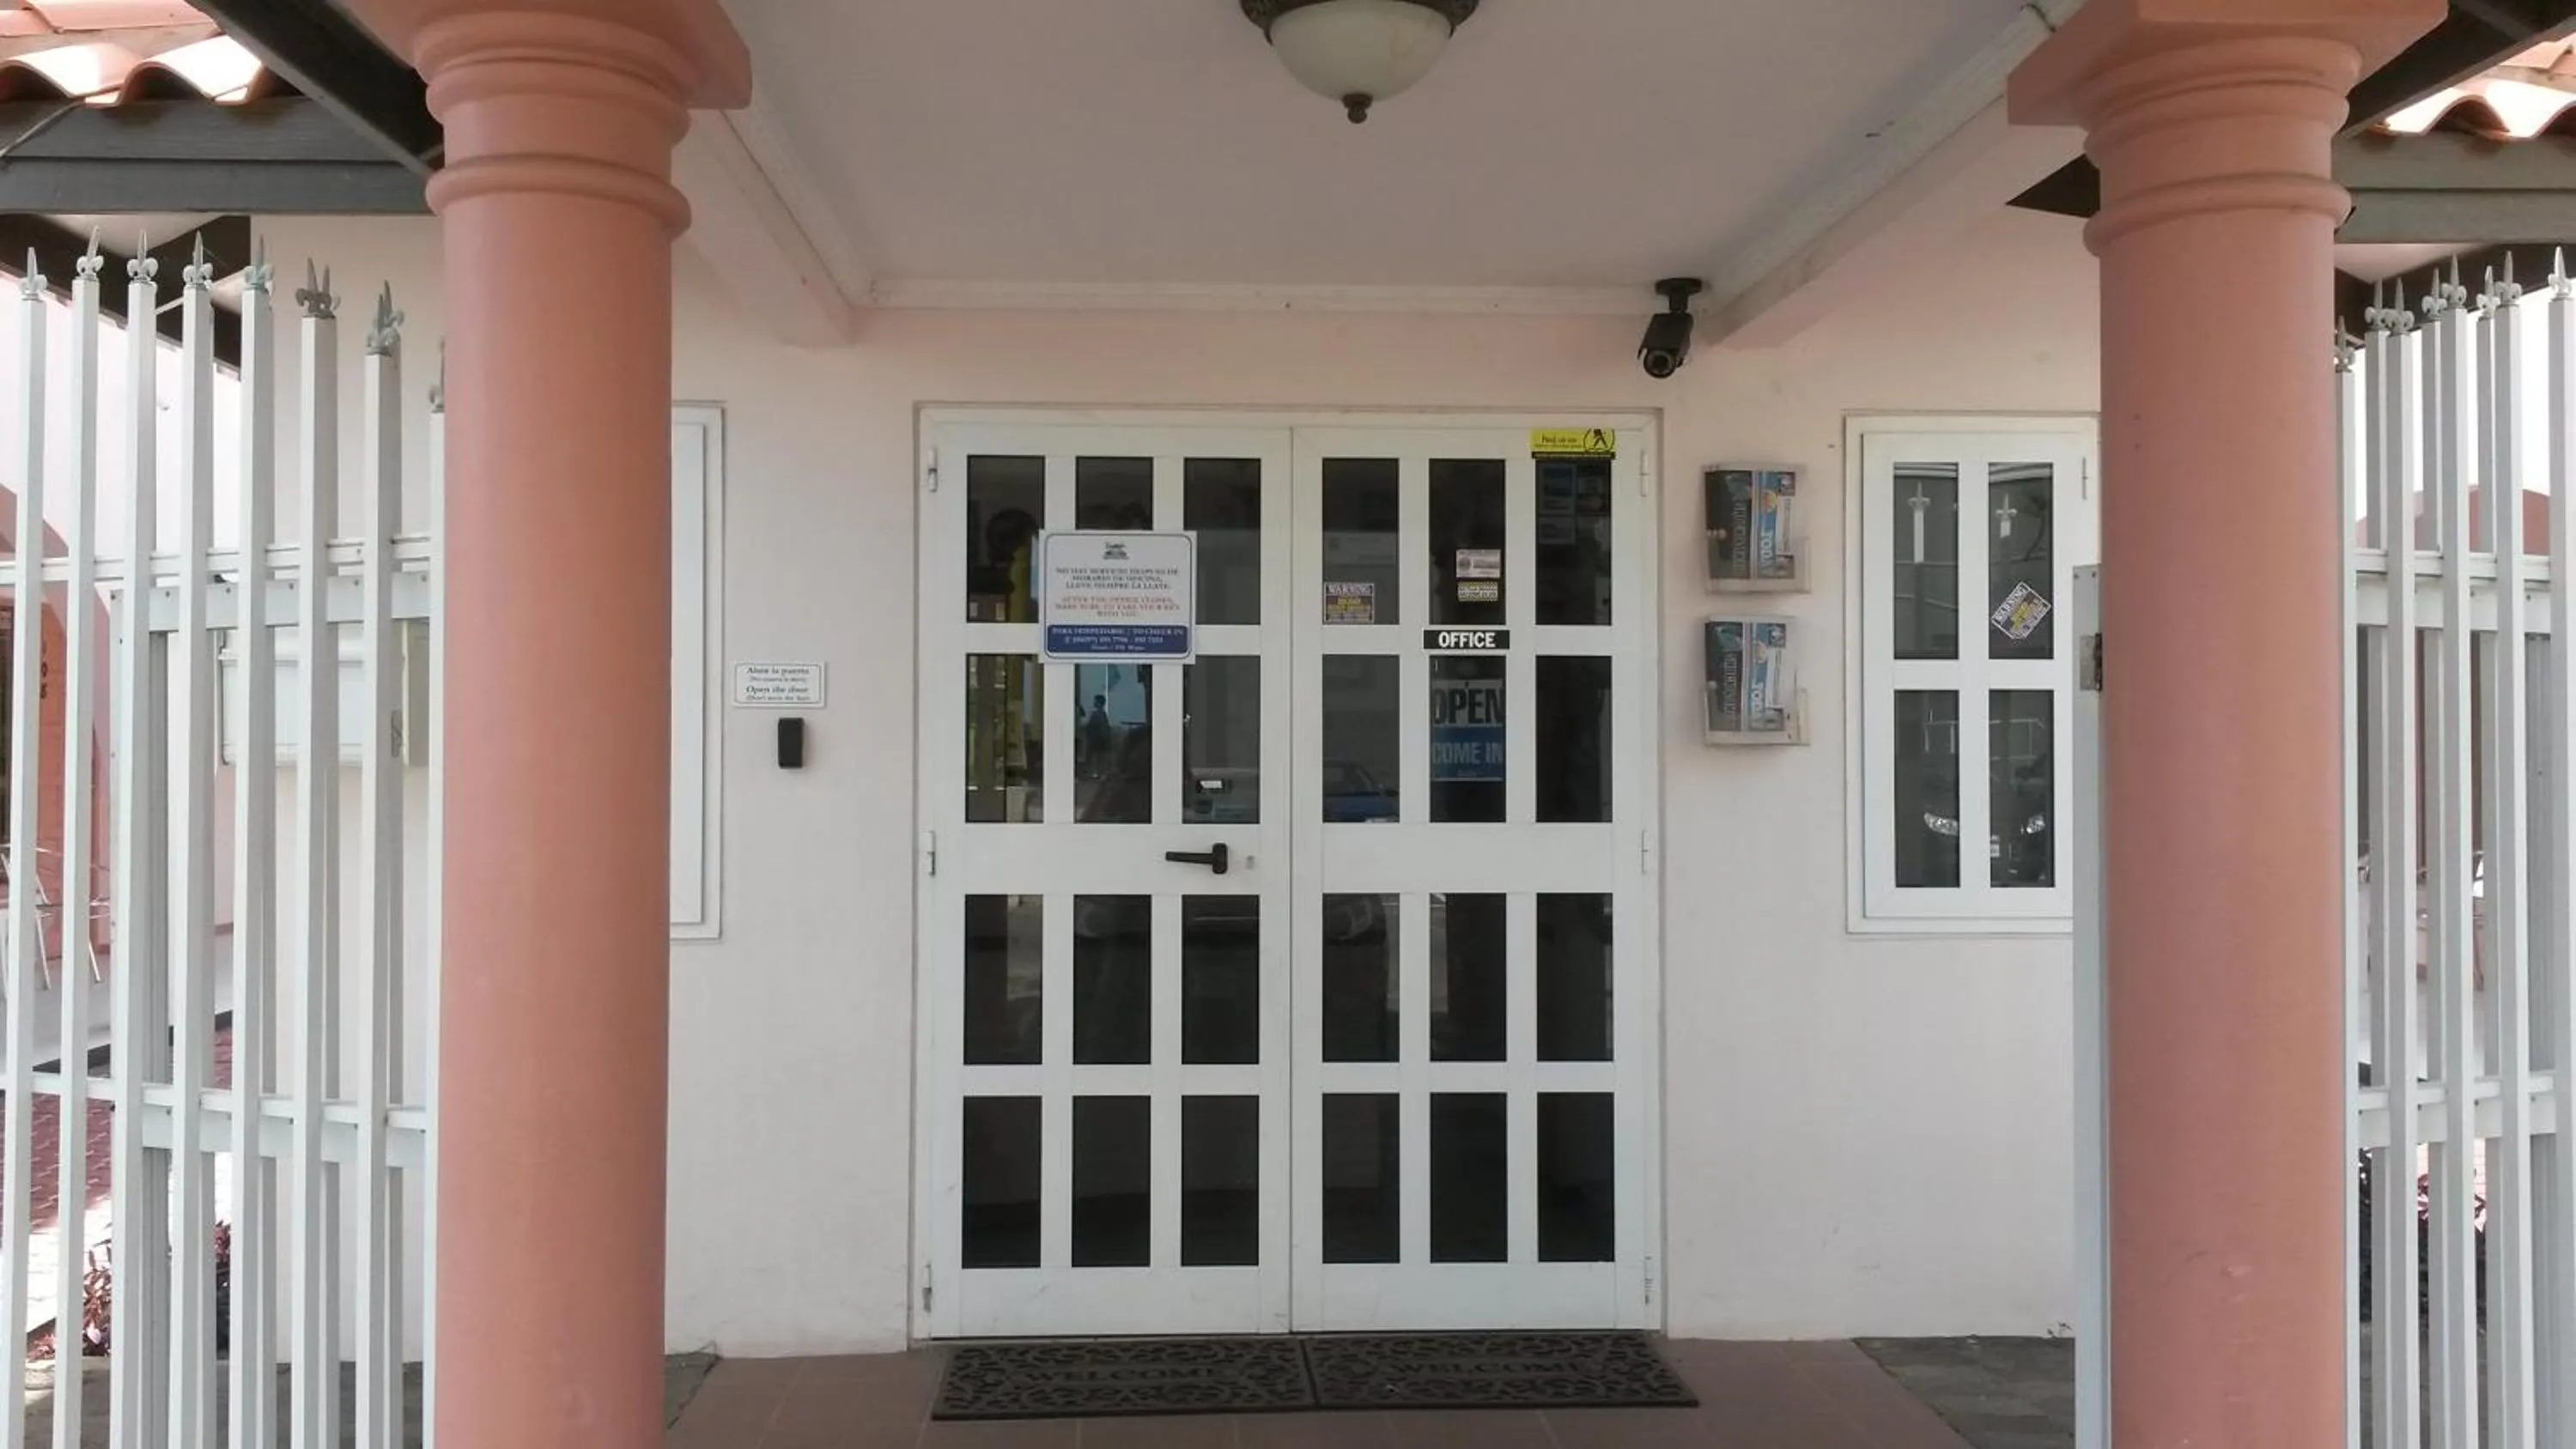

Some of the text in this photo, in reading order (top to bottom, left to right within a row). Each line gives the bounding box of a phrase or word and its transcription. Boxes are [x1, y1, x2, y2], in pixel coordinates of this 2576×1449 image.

[1437, 630, 1497, 648] OFFICE
[1433, 688, 1505, 724] OPEN
[1433, 742, 1504, 765] COME IN
